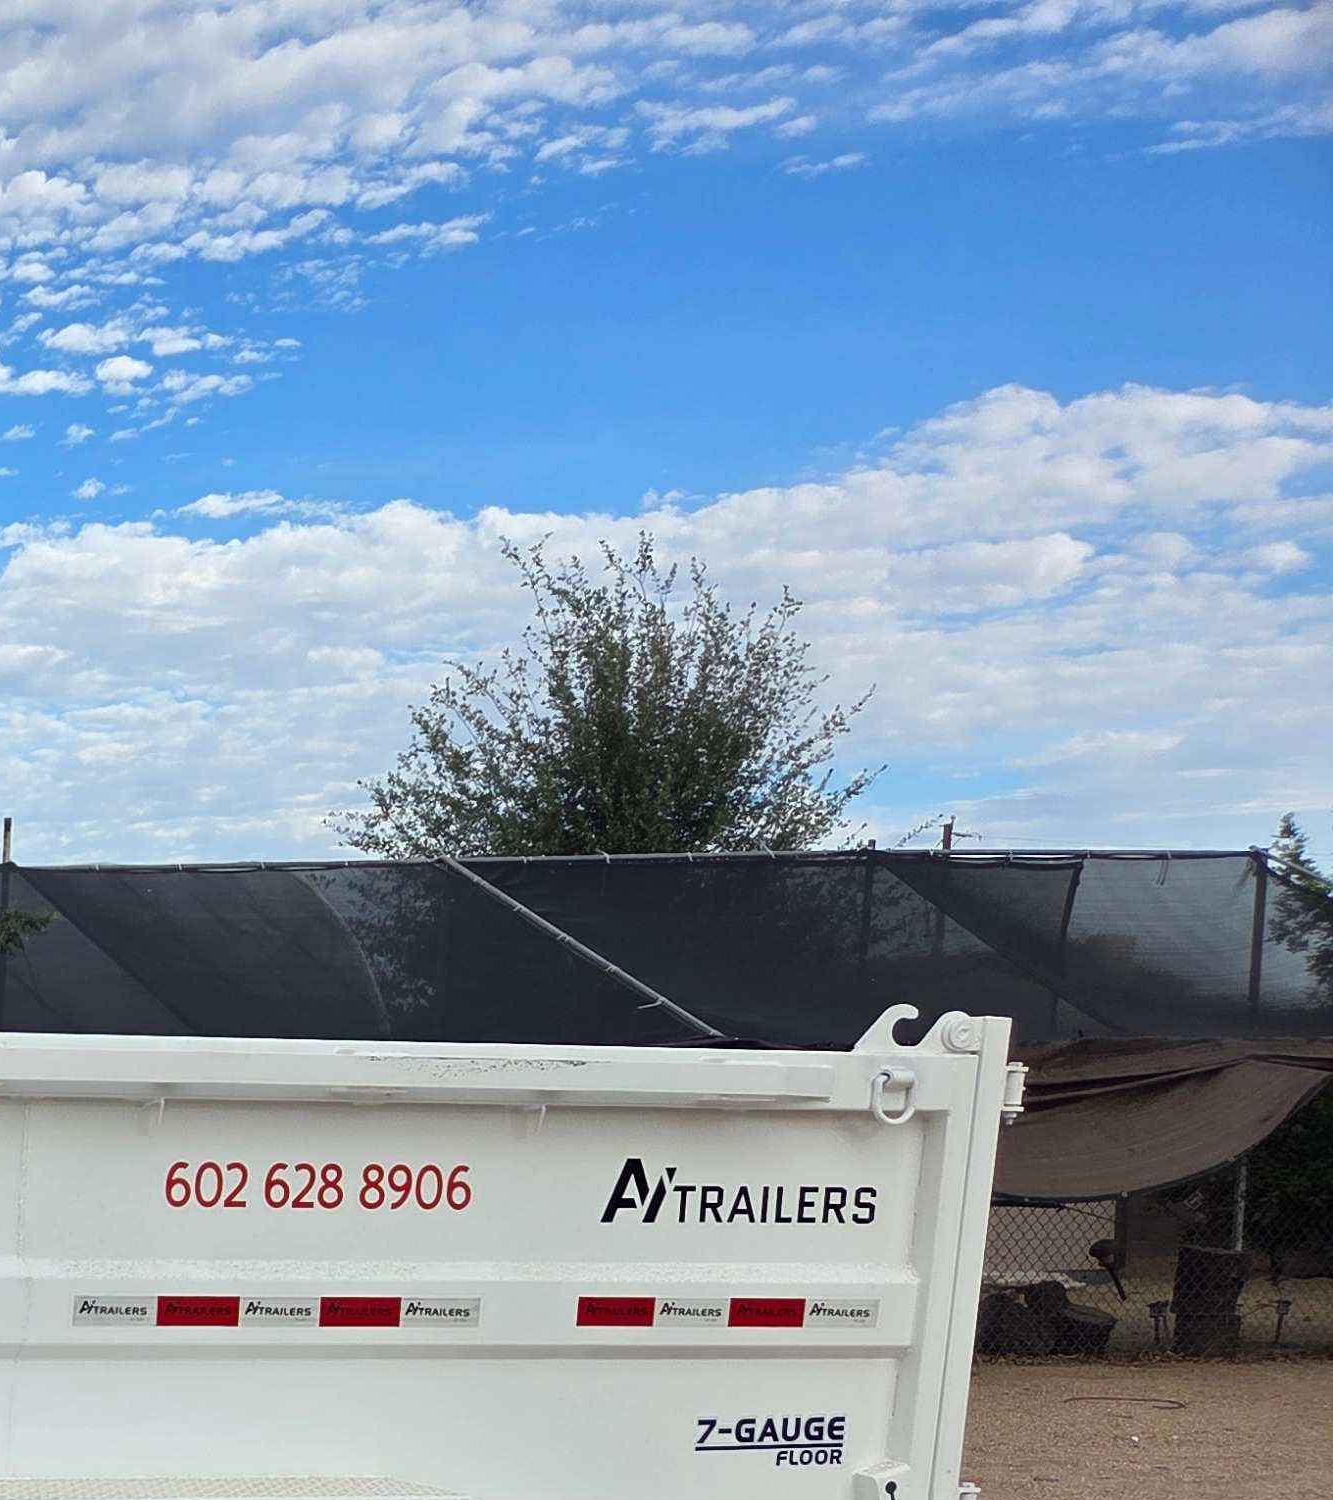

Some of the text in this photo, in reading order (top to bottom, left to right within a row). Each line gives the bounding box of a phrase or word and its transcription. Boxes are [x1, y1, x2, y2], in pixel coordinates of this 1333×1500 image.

[165, 1162, 471, 1210] 602 628 8906
[698, 1417, 846, 1442] 7-GAUGE
[776, 1448, 843, 1466] FLOOR
